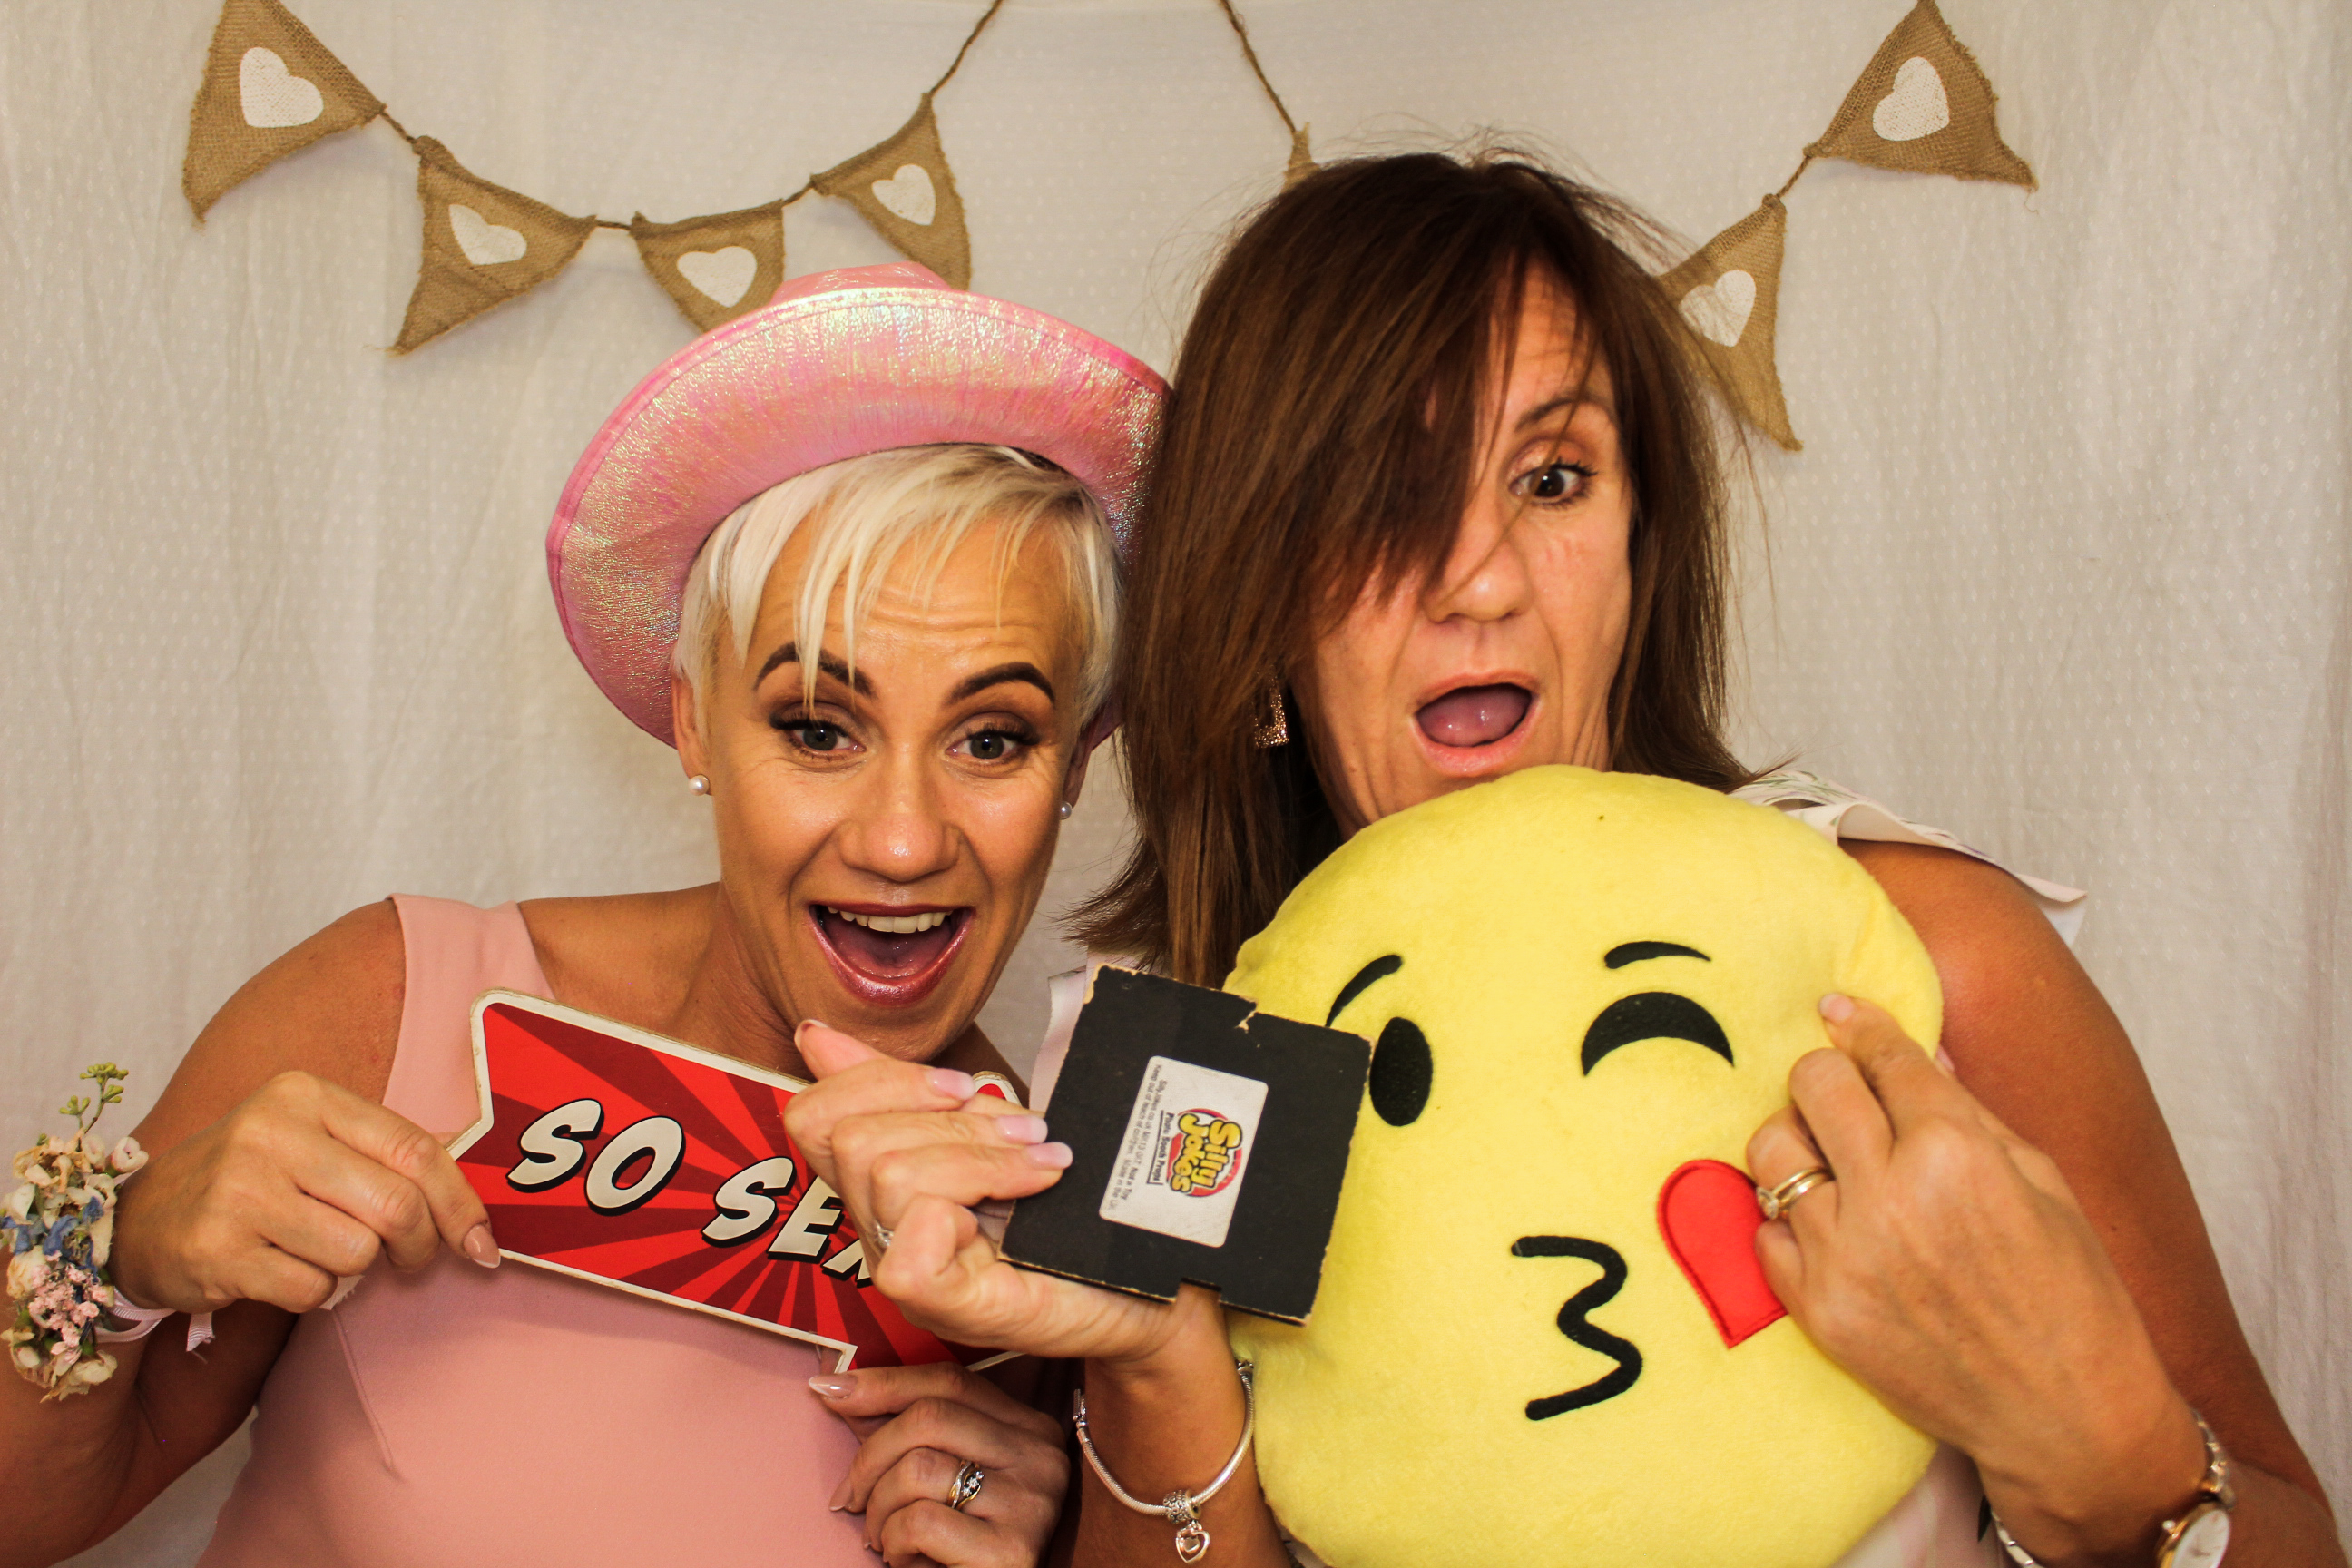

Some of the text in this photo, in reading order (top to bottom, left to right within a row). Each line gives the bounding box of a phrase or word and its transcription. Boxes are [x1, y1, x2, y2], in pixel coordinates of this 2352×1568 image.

[506, 1098, 685, 1216] SO
[1152, 1112, 1174, 1181] Photo Booth Props
[1171, 1112, 1210, 1193] Jokes
[1191, 1119, 1242, 1189] Silly
